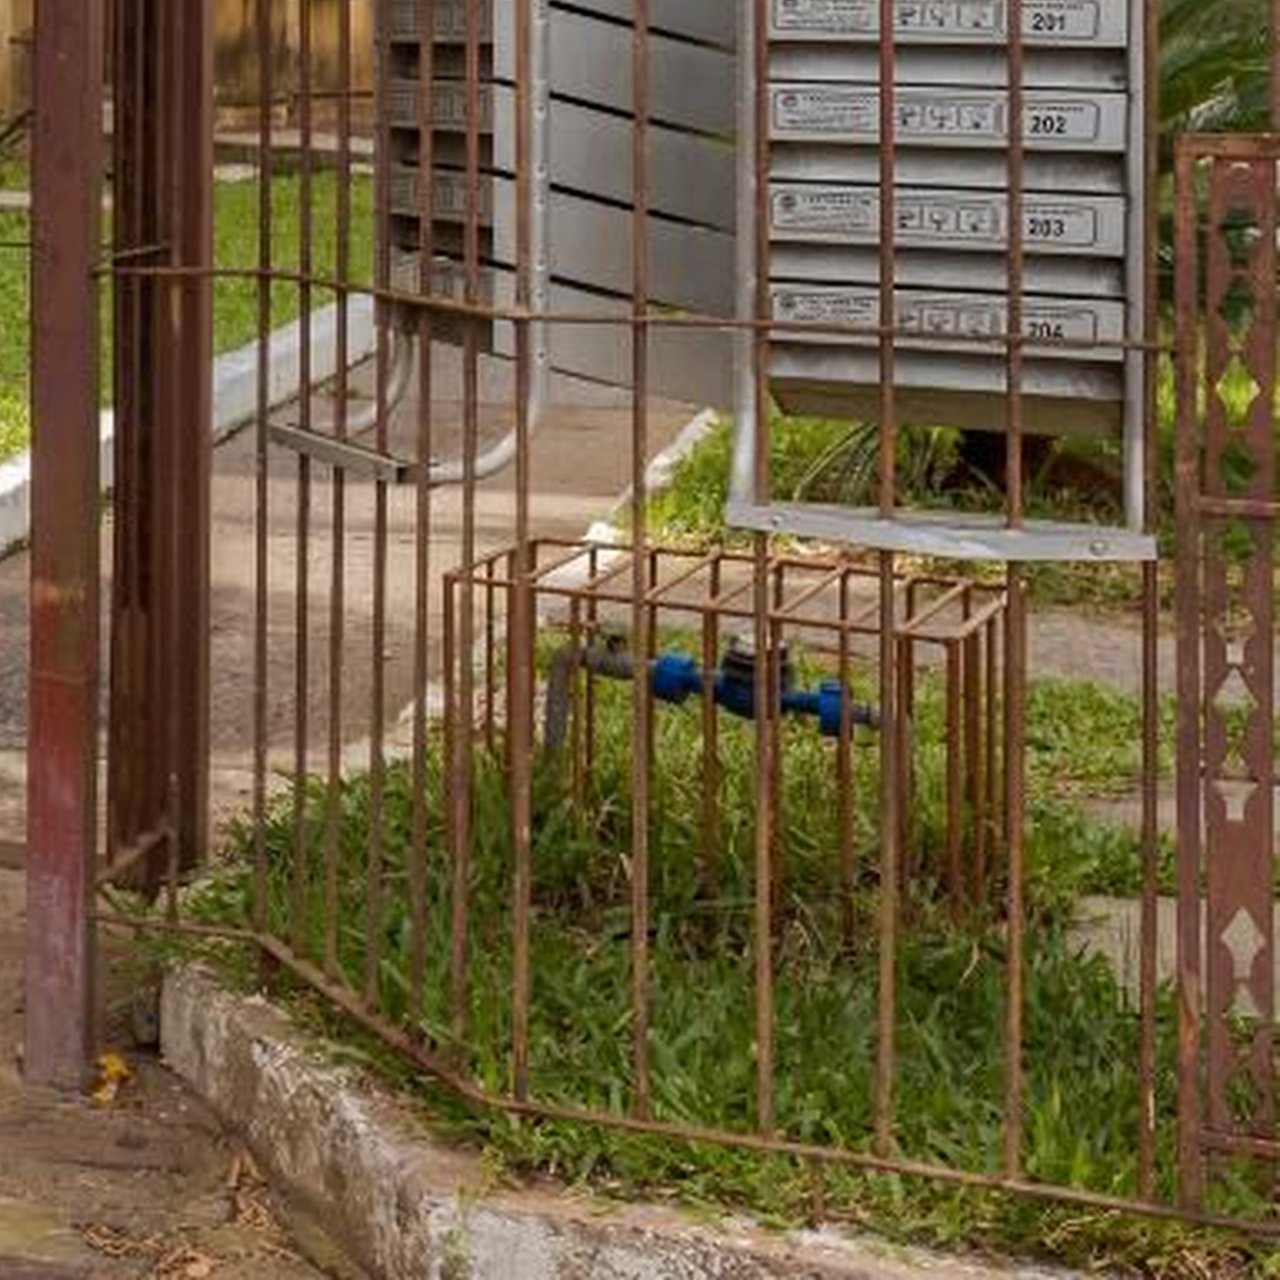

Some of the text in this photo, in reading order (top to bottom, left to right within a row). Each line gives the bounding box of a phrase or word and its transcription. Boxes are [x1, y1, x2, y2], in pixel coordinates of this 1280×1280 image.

[1031, 13, 1067, 32] 201
[1029, 116, 1067, 134] 202
[1028, 218, 1066, 237] 203
